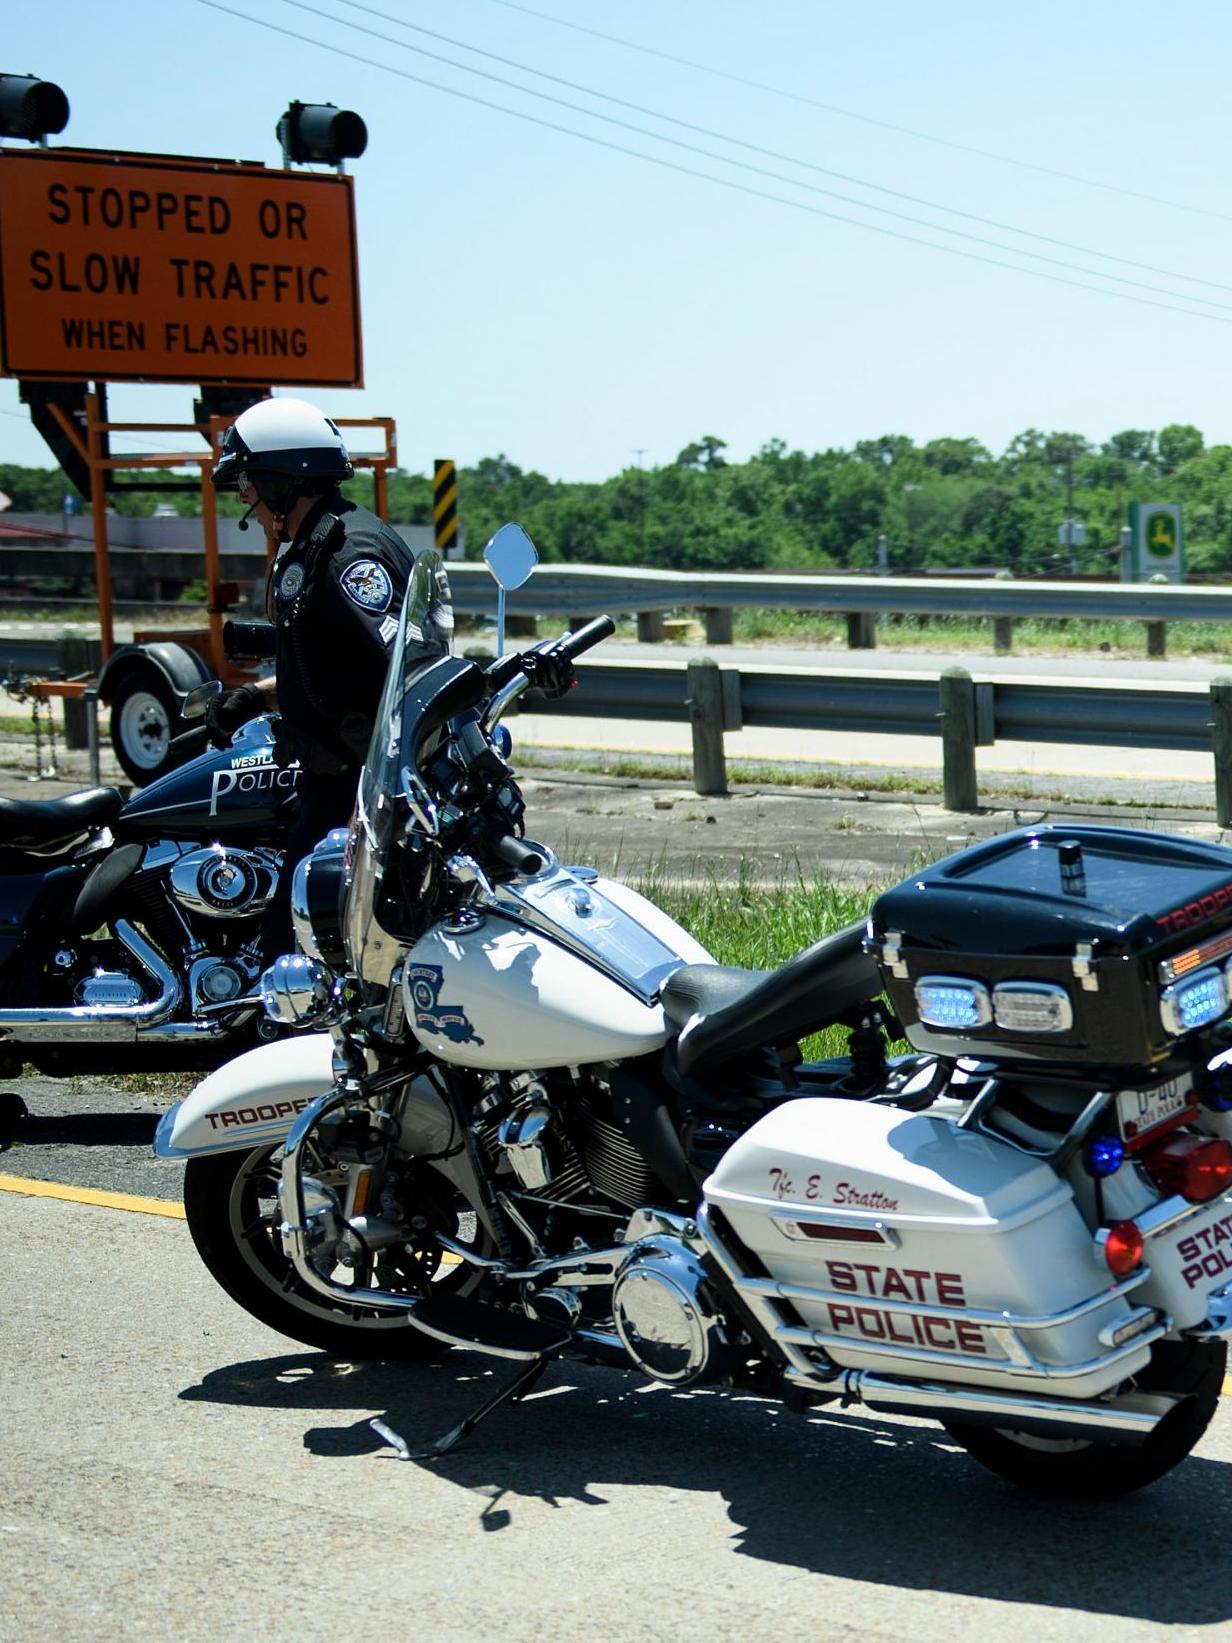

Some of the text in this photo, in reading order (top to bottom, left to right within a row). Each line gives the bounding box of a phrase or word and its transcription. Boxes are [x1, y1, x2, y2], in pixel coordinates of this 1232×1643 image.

[48, 184, 308, 240] STOPPED OR
[30, 250, 329, 305] SLOW TRAFFIC
[61, 318, 308, 358] WHEN FLASHING
[205, 1096, 319, 1129] TROOPE
[805, 1174, 824, 1200] E.
[833, 1182, 899, 1211] Stratton
[825, 1260, 967, 1307] STATE
[826, 1303, 987, 1354] POLICE
